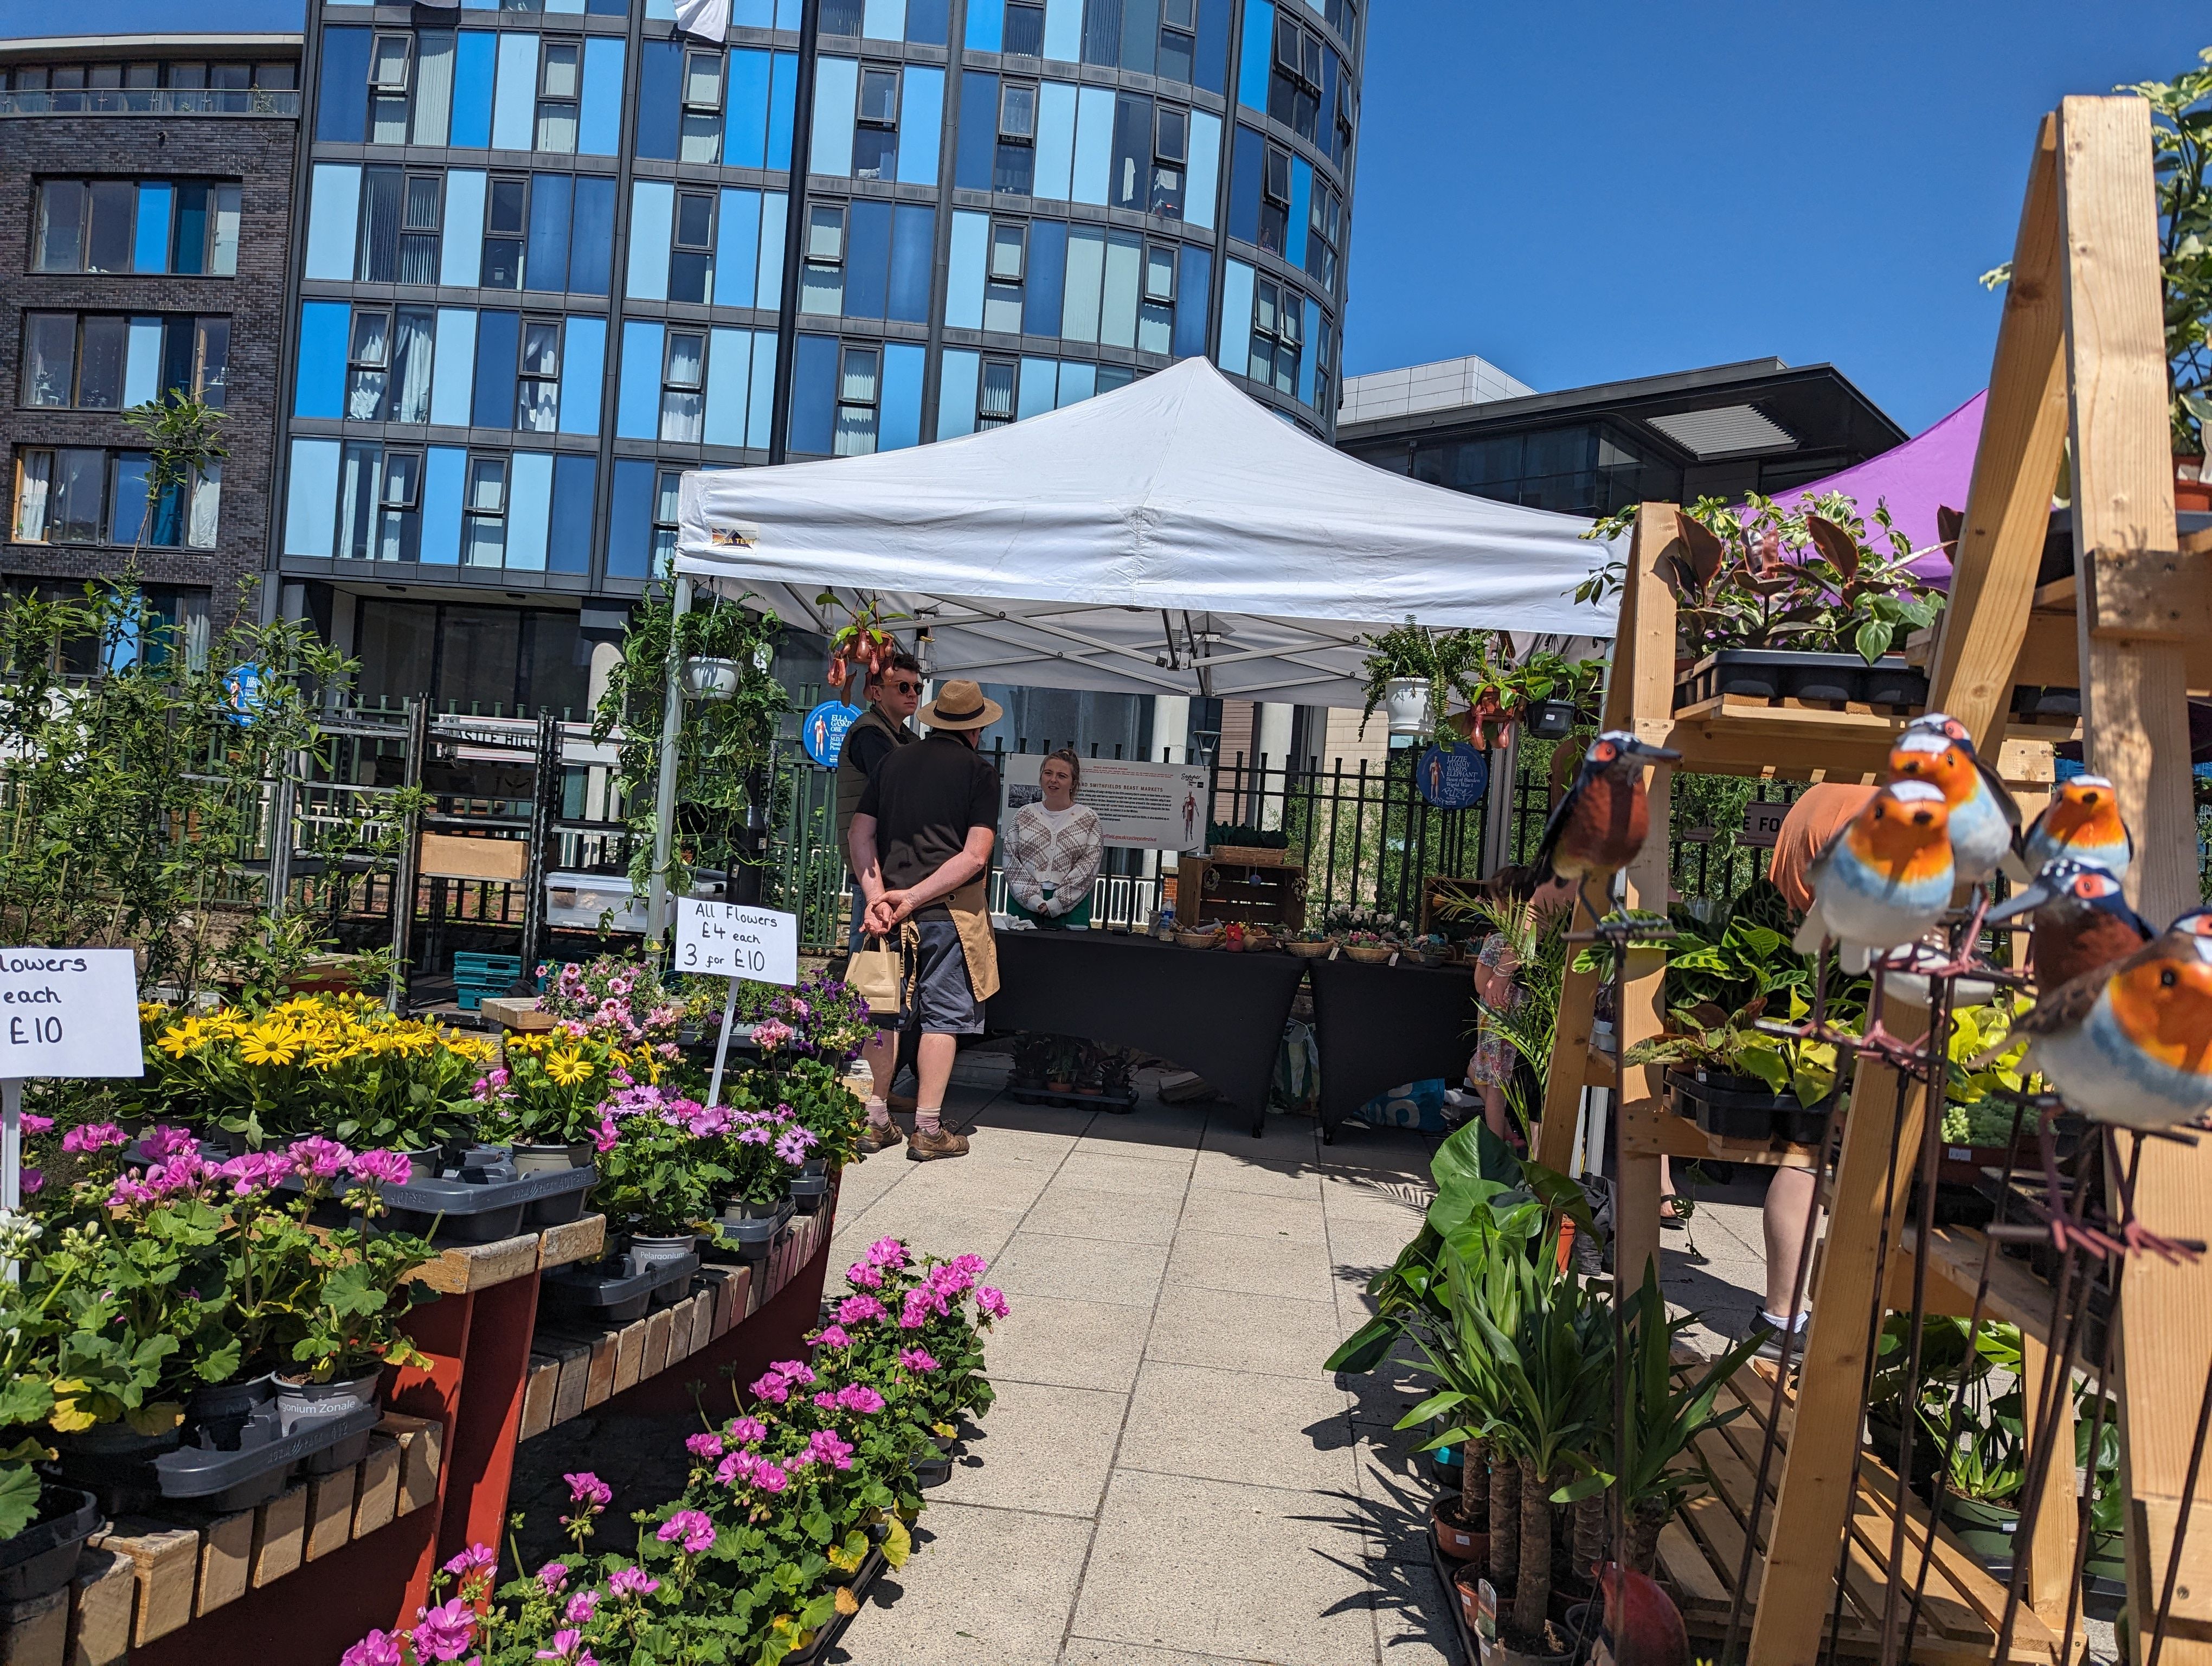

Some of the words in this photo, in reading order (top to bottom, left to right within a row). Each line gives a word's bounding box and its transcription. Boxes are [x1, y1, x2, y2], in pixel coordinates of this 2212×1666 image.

[1759, 817, 1784, 832] FO
[696, 902, 716, 918] All
[726, 906, 778, 927] Flowers
[702, 921, 726, 940] £4
[732, 933, 761, 945] each
[684, 943, 698, 966] 3
[705, 956, 725, 968] for
[735, 948, 765, 972] £10
[3, 986, 62, 1004] each
[10, 1016, 63, 1045] £10
[640, 1251, 685, 1260] Pelargonium
[319, 1400, 356, 1413] Zonale
